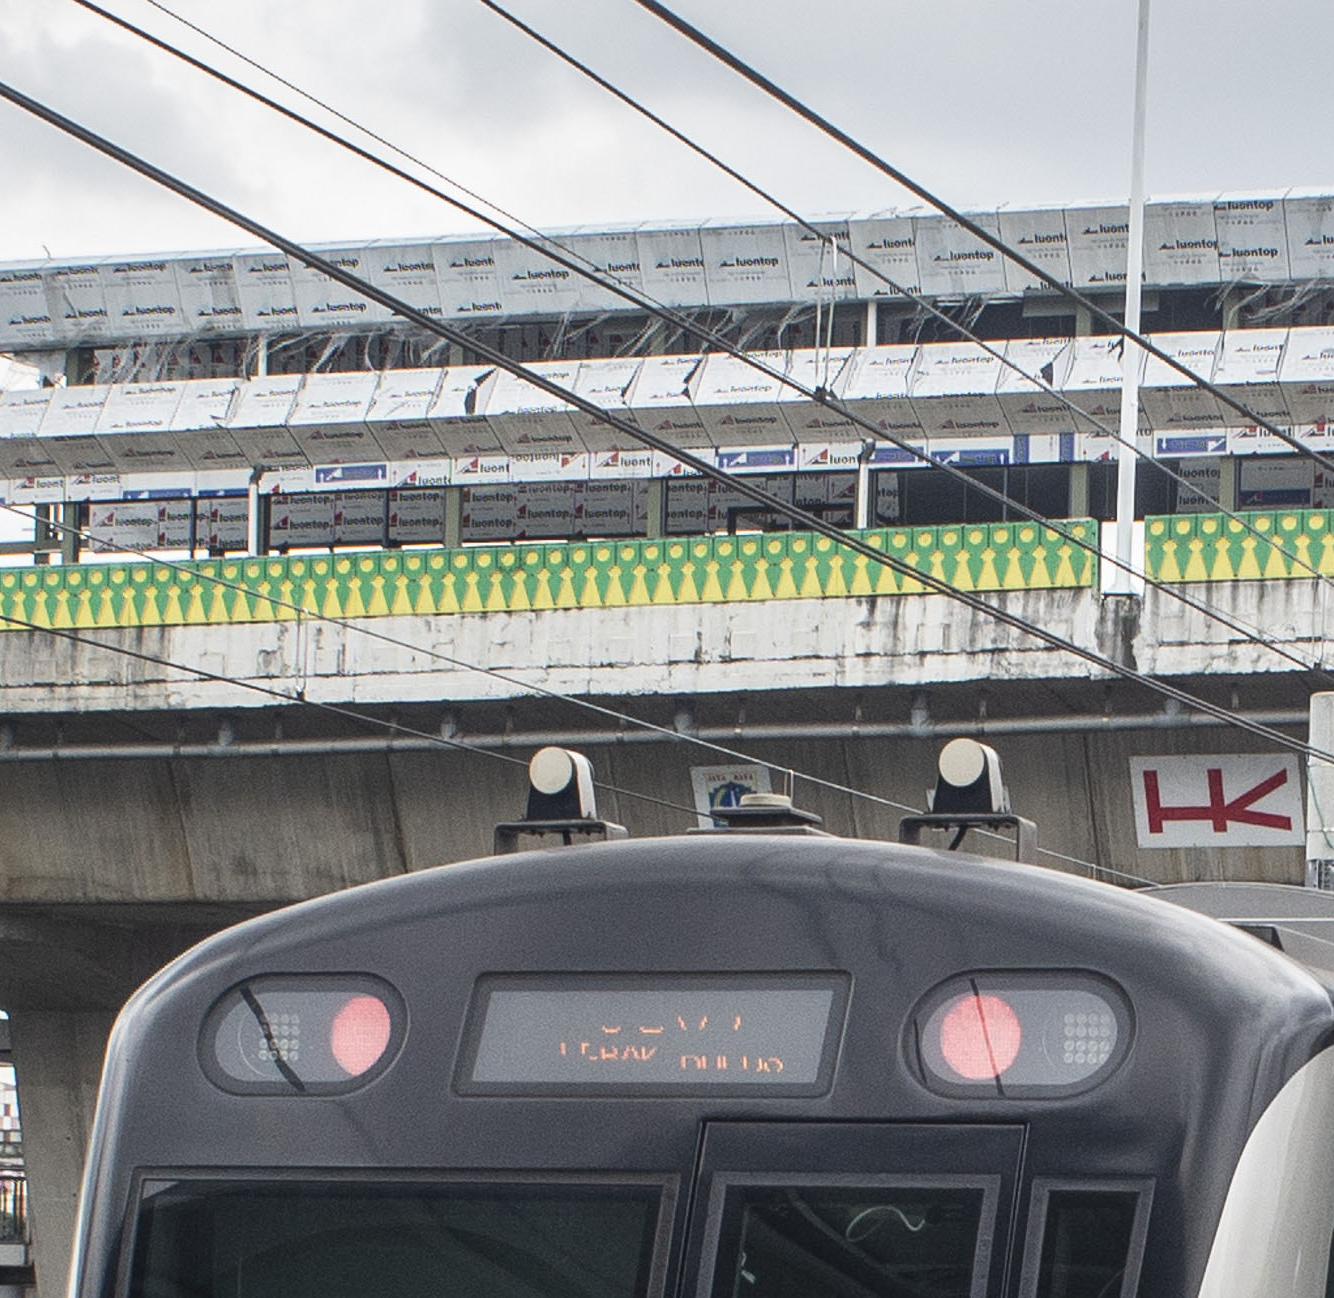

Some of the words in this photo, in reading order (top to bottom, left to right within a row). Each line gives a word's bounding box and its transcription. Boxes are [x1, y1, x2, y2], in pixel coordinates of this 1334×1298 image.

[950, 249, 994, 262] luontop
[1231, 246, 1278, 259] luontop
[735, 256, 779, 269] luontop
[527, 269, 569, 281] luontop
